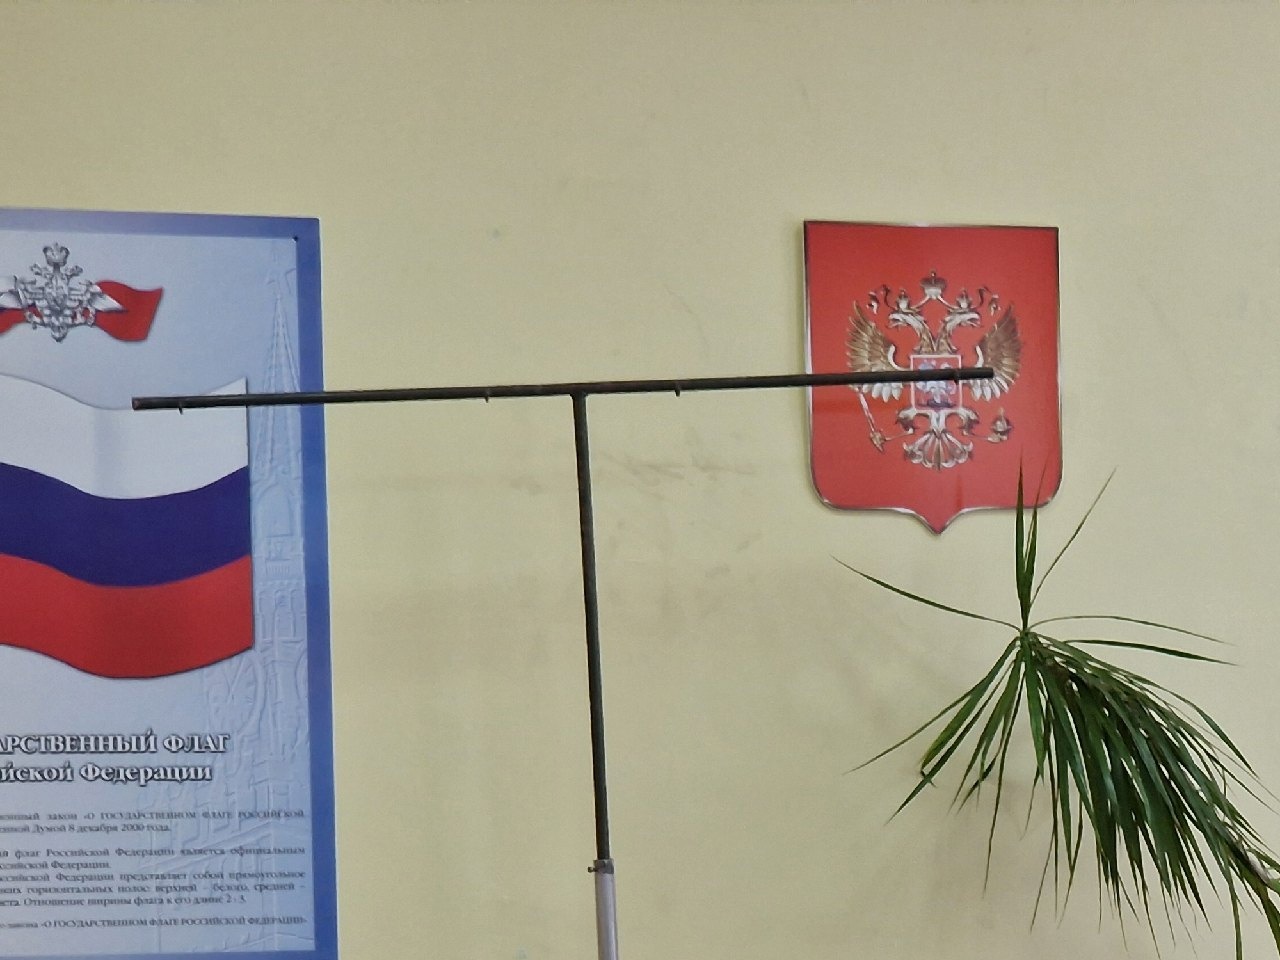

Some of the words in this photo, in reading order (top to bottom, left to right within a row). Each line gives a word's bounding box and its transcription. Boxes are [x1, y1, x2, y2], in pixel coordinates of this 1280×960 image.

[163, 733, 230, 753] ФЛАГ
[0, 760, 74, 782] йской
[80, 762, 212, 787] Федерации
[122, 823, 144, 832] 2000
[47, 848, 109, 857] Российской
[115, 847, 175, 858] Федерации
[56, 873, 113, 883] Федерации
[54, 919, 147, 928] ГОСУДАРСТВЕННОМ
